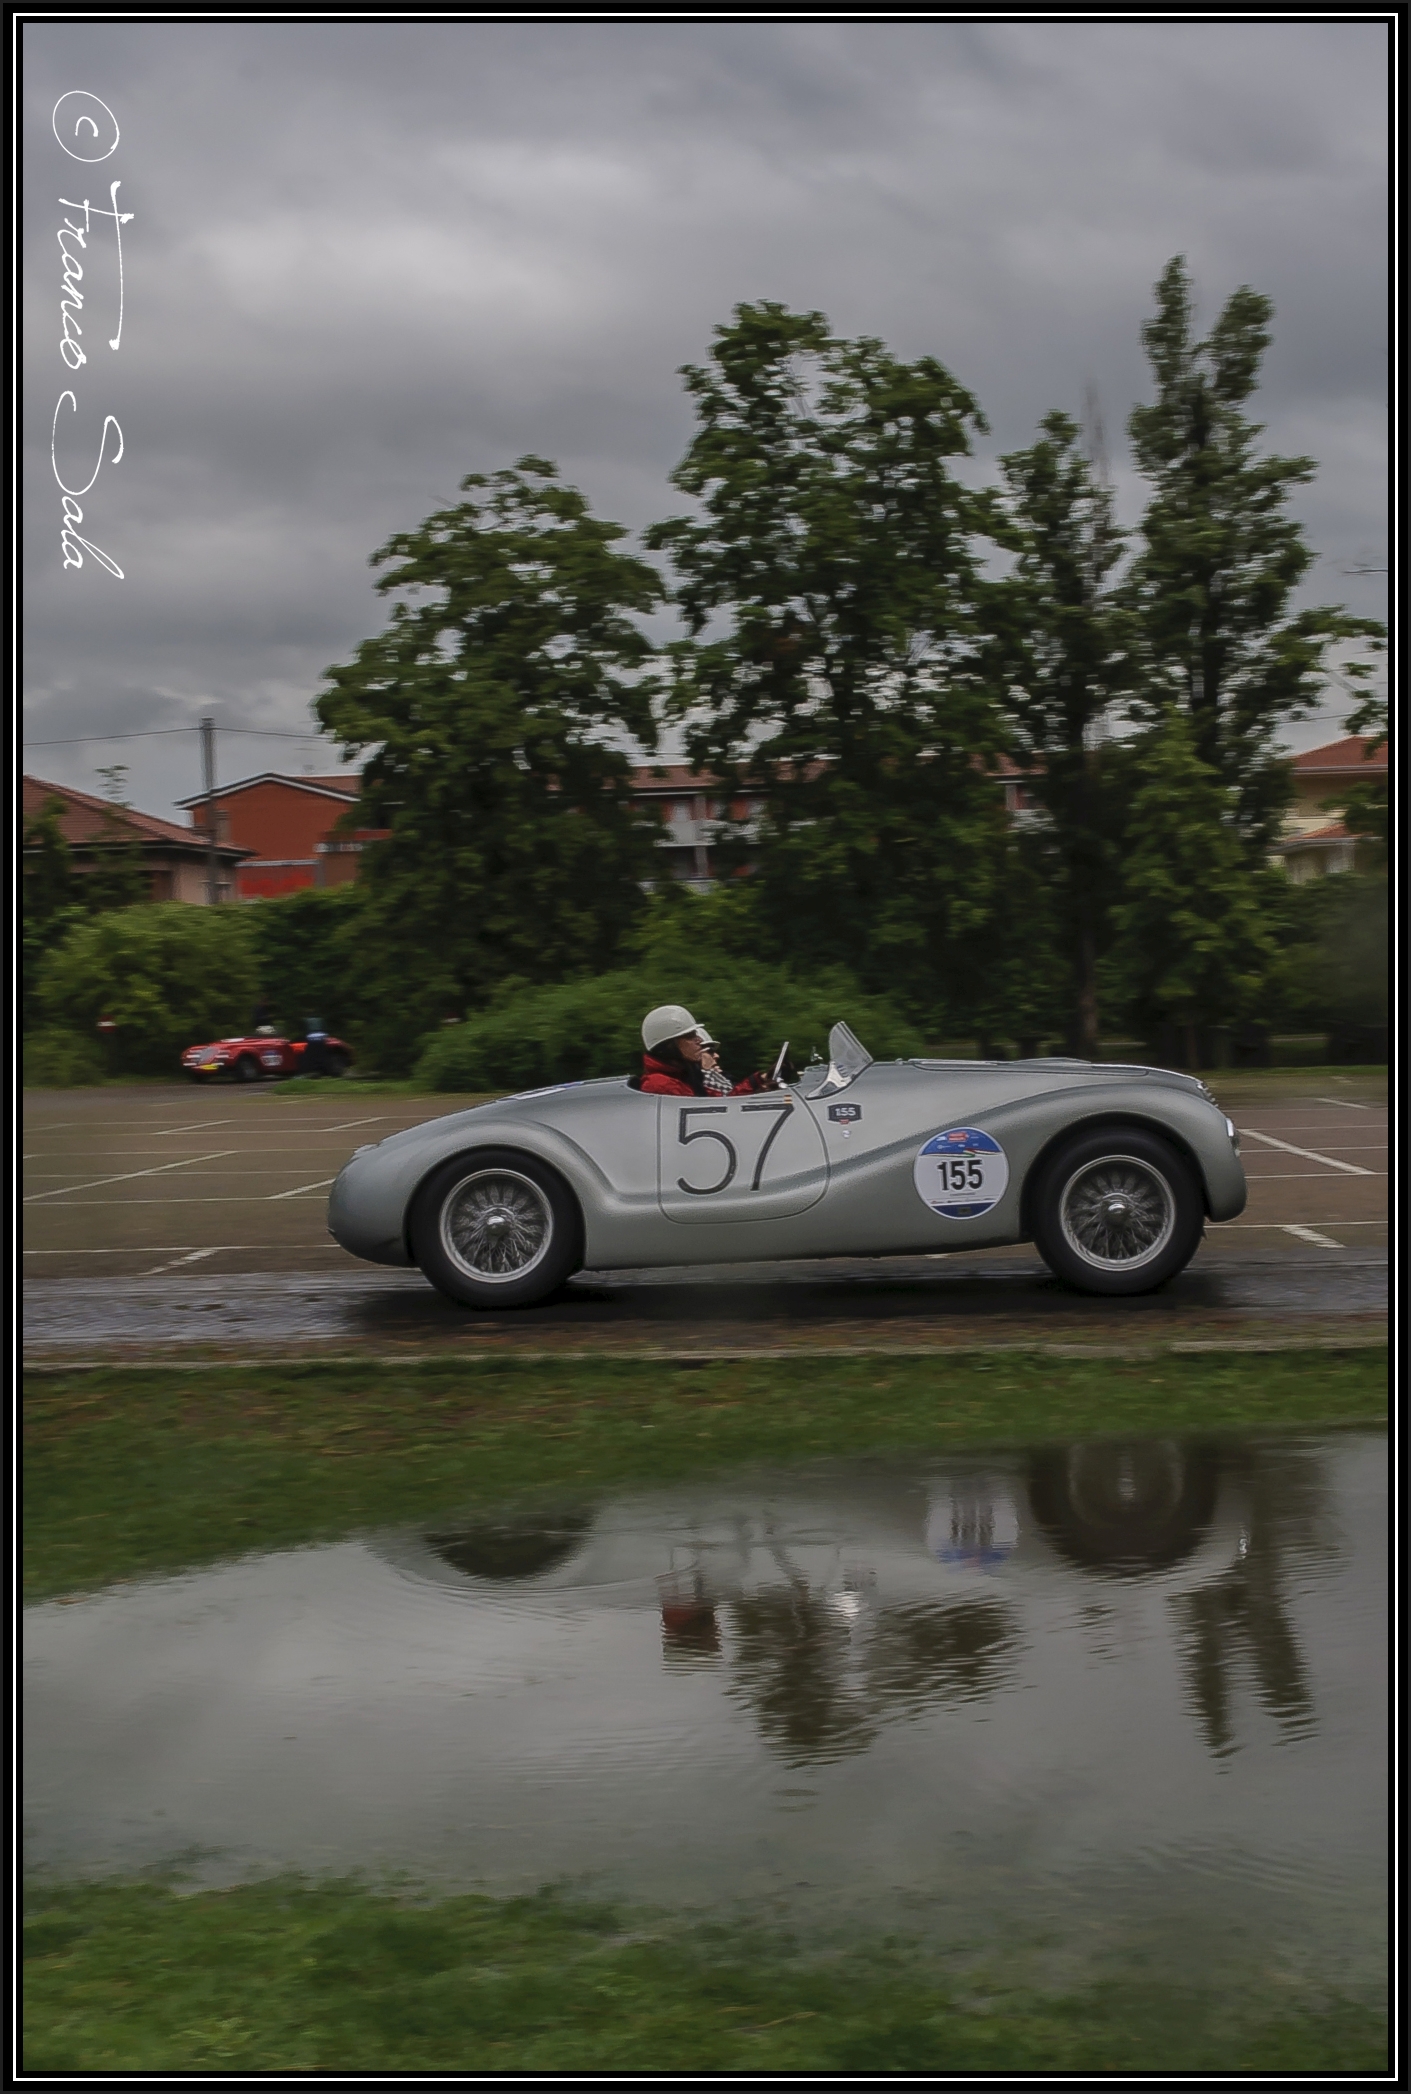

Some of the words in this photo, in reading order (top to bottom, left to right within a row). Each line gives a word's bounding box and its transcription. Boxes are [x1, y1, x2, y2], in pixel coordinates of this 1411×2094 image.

[835, 1107, 856, 1116] 155
[677, 1103, 794, 1195] 57
[937, 1159, 983, 1191] 155
